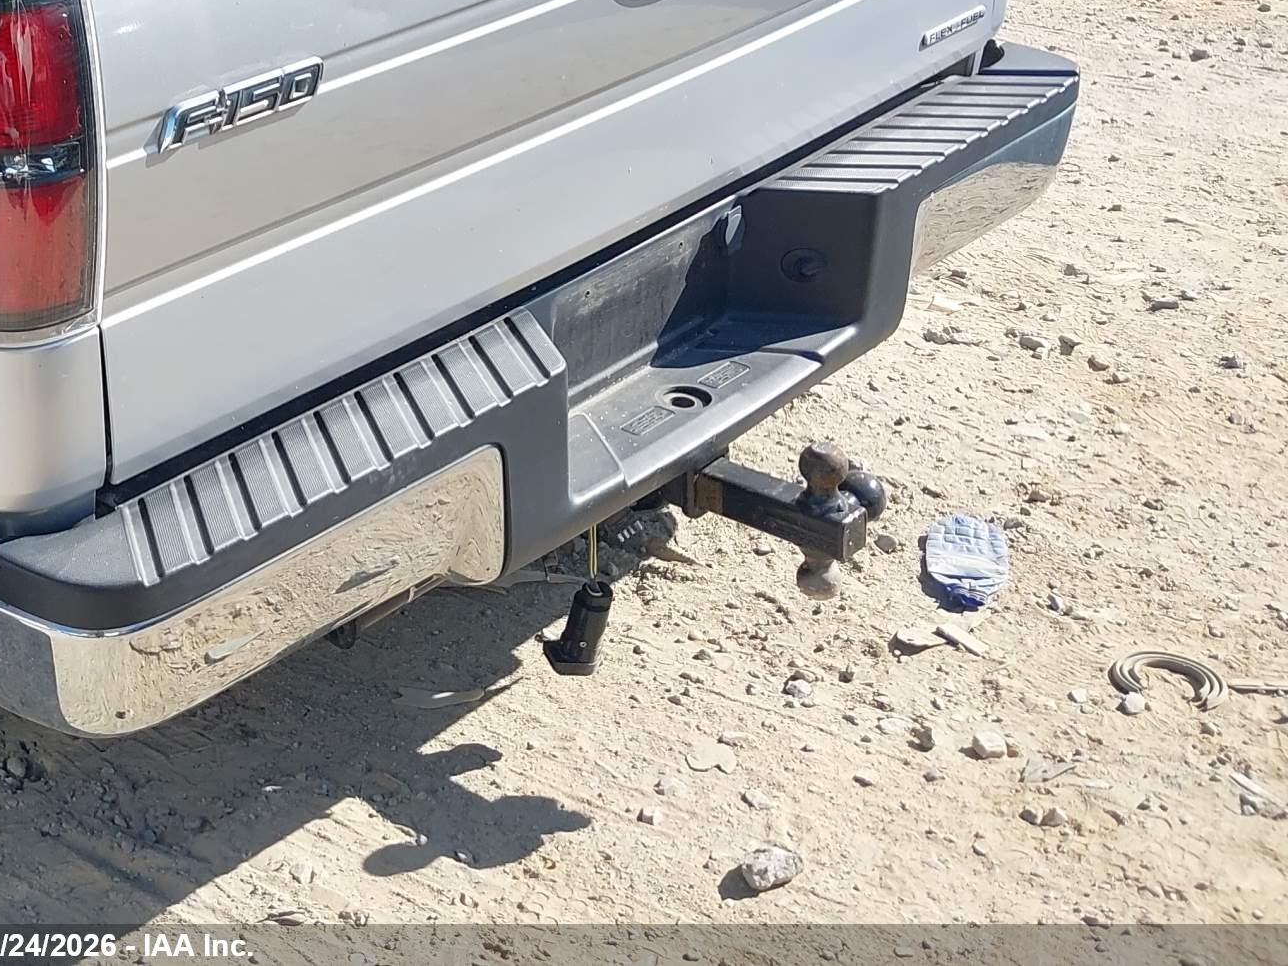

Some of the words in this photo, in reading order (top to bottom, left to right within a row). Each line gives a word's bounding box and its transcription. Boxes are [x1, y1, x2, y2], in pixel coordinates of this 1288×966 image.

[929, 24, 953, 44] FLEX
[960, 10, 985, 28] FUEL
[159, 55, 324, 155] F-150
